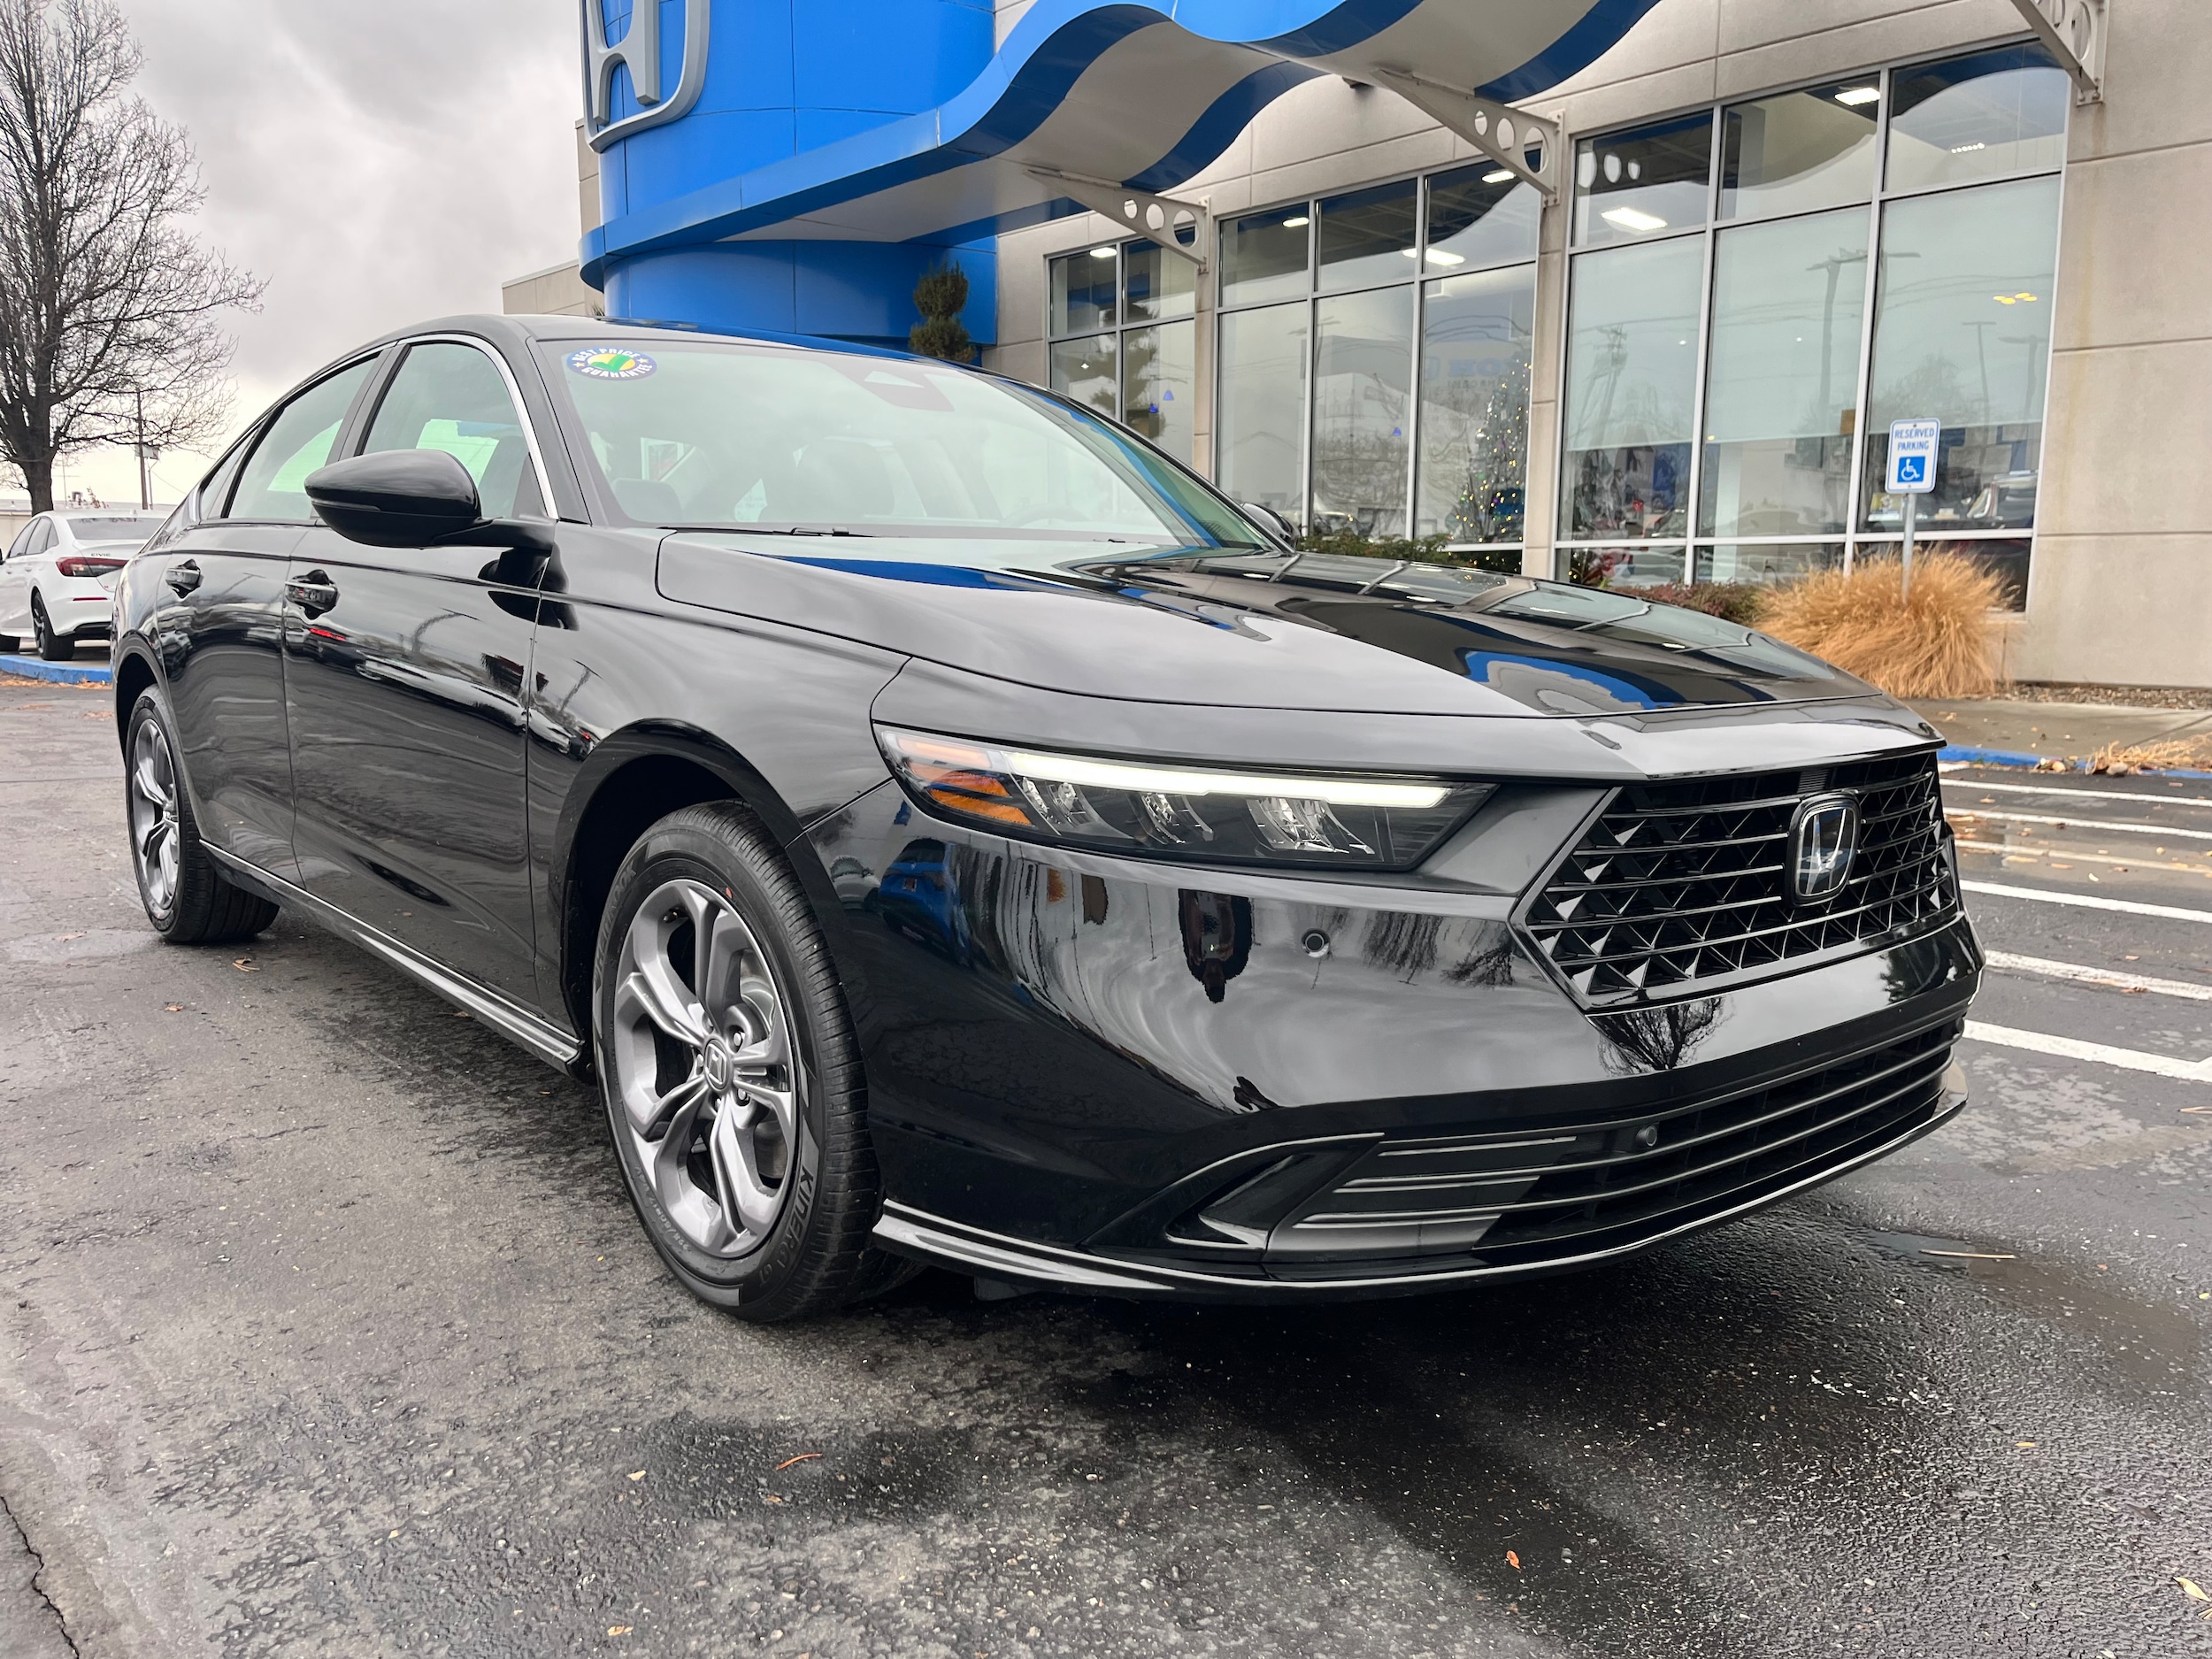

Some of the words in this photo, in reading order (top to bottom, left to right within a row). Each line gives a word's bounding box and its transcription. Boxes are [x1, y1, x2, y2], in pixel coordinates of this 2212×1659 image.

[572, 349, 597, 362] BEST
[598, 348, 641, 359] PRICE
[580, 364, 653, 378] GUARANTEE
[1894, 427, 1935, 439] RESERVED
[1897, 441, 1930, 451] PARKING
